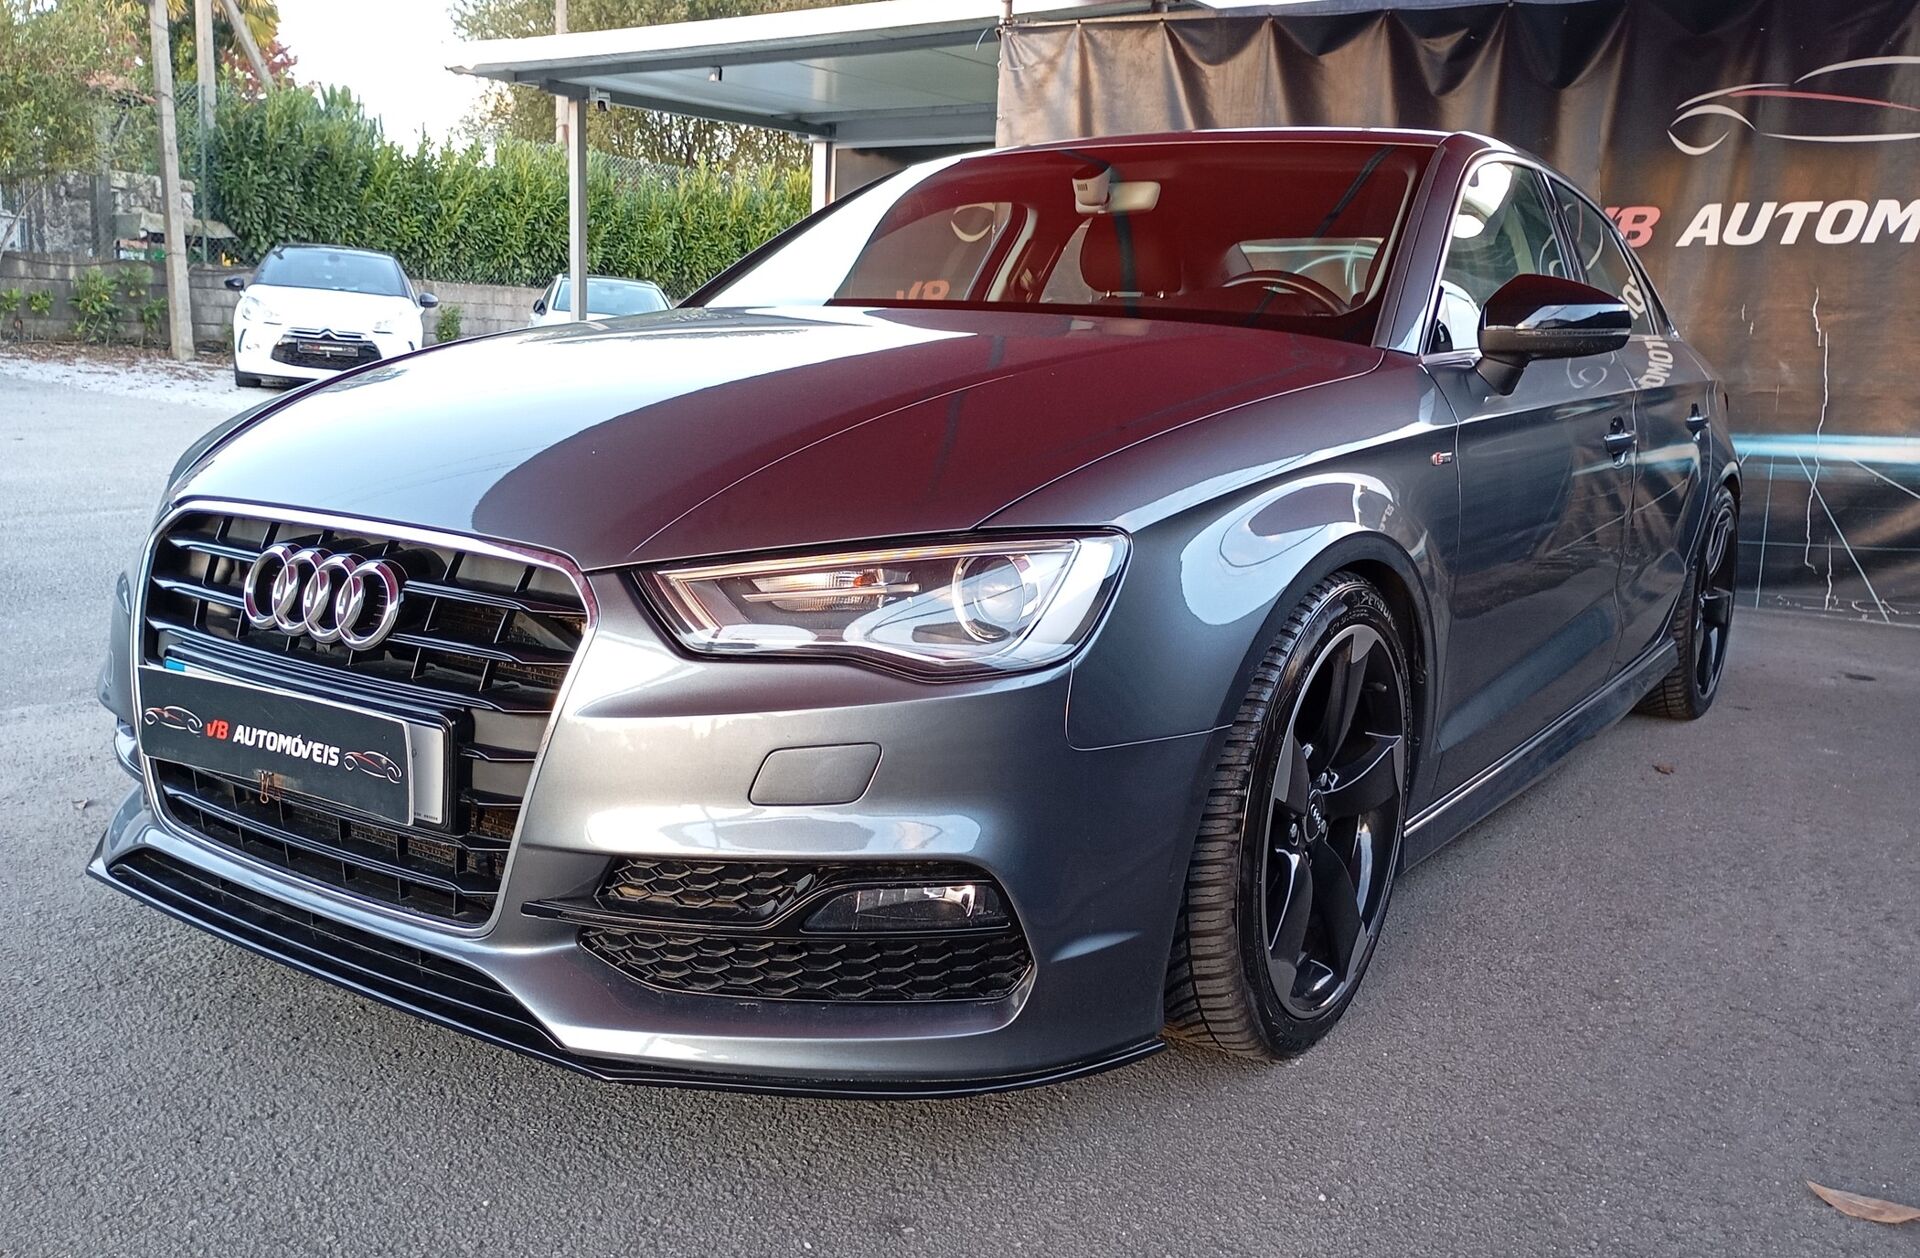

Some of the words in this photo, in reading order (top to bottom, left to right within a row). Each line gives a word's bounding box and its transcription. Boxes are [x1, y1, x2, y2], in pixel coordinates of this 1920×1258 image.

[1675, 199, 1920, 247] AUTOM
[206, 719, 229, 740] VB
[232, 724, 340, 767] AUTOMÓVEIS
